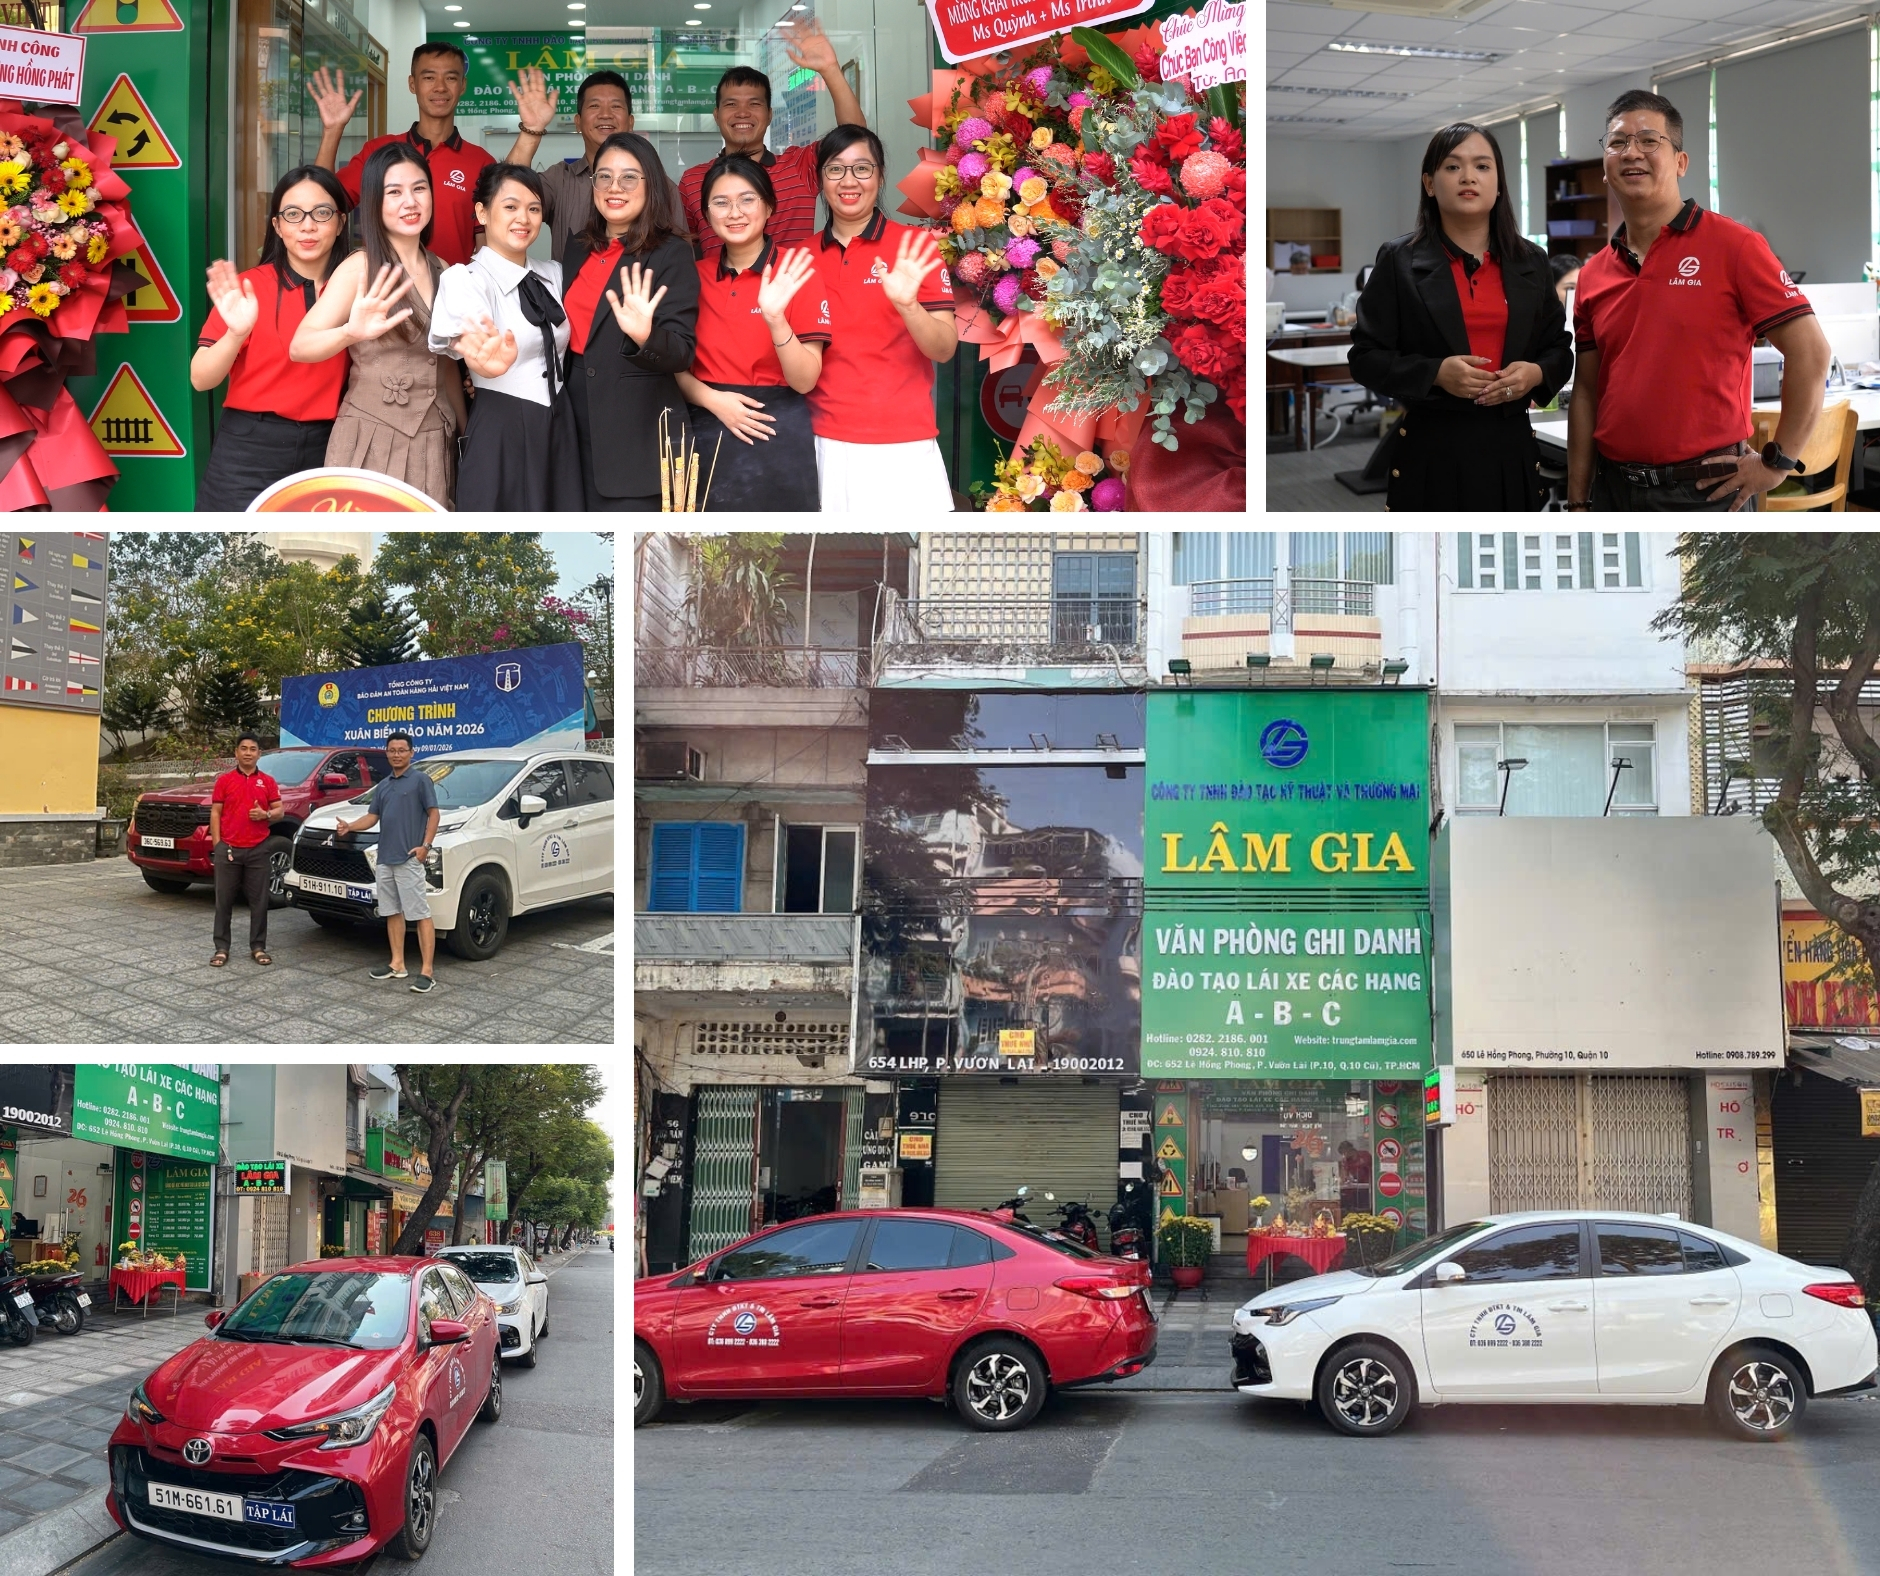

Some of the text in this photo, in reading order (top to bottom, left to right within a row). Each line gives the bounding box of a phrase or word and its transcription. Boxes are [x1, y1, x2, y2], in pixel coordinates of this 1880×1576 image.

[972, 24, 991, 42] Ms
[993, 10, 1037, 38] Quỳnh
[1050, 1, 1071, 20] Ms
[1161, 17, 1194, 42] Chúc
[21, 40, 60, 57] CÔNG
[496, 35, 565, 45] TY TNHH ĐÀO
[505, 45, 599, 71] LÂM
[1161, 37, 1227, 79] Chúc Bạn Công
[16, 58, 75, 90] HỒNG PHÁT
[634, 73, 671, 81] DANH
[474, 85, 502, 95] ĐÀO
[1669, 277, 1702, 287] LÂM GIA
[388, 680, 405, 689] TỔNG
[406, 679, 423, 687] CÔNG
[393, 687, 409, 696] TOÀN
[409, 686, 427, 694] HÀNG
[428, 684, 438, 693] HẢI
[439, 683, 453, 693] VIỆT
[367, 701, 456, 723] CHƯƠNG TRÌNH
[344, 727, 371, 740] XUÂN
[373, 724, 396, 739] BIỂN
[427, 723, 453, 737] NĂM
[456, 723, 485, 735] 2026
[421, 743, 453, 752] 09/01/2026
[1151, 780, 1179, 800] CÔNG
[1184, 784, 1196, 800] TY
[1201, 784, 1227, 800] TNHH
[1161, 821, 1415, 873] LÂM GIA
[303, 878, 371, 900] 51H-911.10 TẬP LÁI
[1156, 922, 1421, 956] VĂN PHÒNG GHI DANH
[1152, 968, 1421, 994] ĐÀO TẠO LÁI XE CÁC HẠNG
[1225, 1000, 1341, 1026] A B C
[1146, 1033, 1268, 1044] Hotline: 0282. 2186. 001
[1294, 1035, 1418, 1046] Website: trungtamlamgia.com
[1189, 1047, 1266, 1058] 0924. 810. 810
[1461, 1048, 1609, 1061] 650 Lê Hồng Phong, 10, Quận 10
[1695, 1051, 1776, 1059] Hotline: 0908.789.299
[868, 1056, 896, 1069] 654
[900, 1057, 929, 1073] LHP,
[935, 1057, 950, 1070] P.
[1007, 1057, 1035, 1070] LAI
[1052, 1057, 1124, 1070] 19002012
[1147, 1059, 1162, 1068] ĐC:
[1165, 1060, 1182, 1068] 652
[1340, 1061, 1361, 1070] Q.10
[1385, 1061, 1420, 1070] TP.HCM
[140, 1066, 157, 1085] LÁI
[160, 1073, 172, 1090] XE
[175, 1079, 193, 1097] CÁC
[195, 1086, 217, 1105] HẠNG
[127, 1086, 185, 1119] A B C
[2, 1105, 62, 1128] 19002012
[77, 1099, 150, 1124] Hotline: 0282. 2186. 001
[77, 1122, 100, 1134] ĐC: 652
[104, 1118, 148, 1134] 0924. 810. 810
[166, 1165, 208, 1178] LÂM GIA
[236, 1162, 249, 1171] ĐÀO
[250, 1163, 263, 1171] TẠO
[264, 1162, 275, 1170] LÁI
[241, 1170, 261, 1180] LÂM
[67, 1188, 87, 1208] 26
[155, 1487, 293, 1523] 51M-661.61 TẬP LÁI
